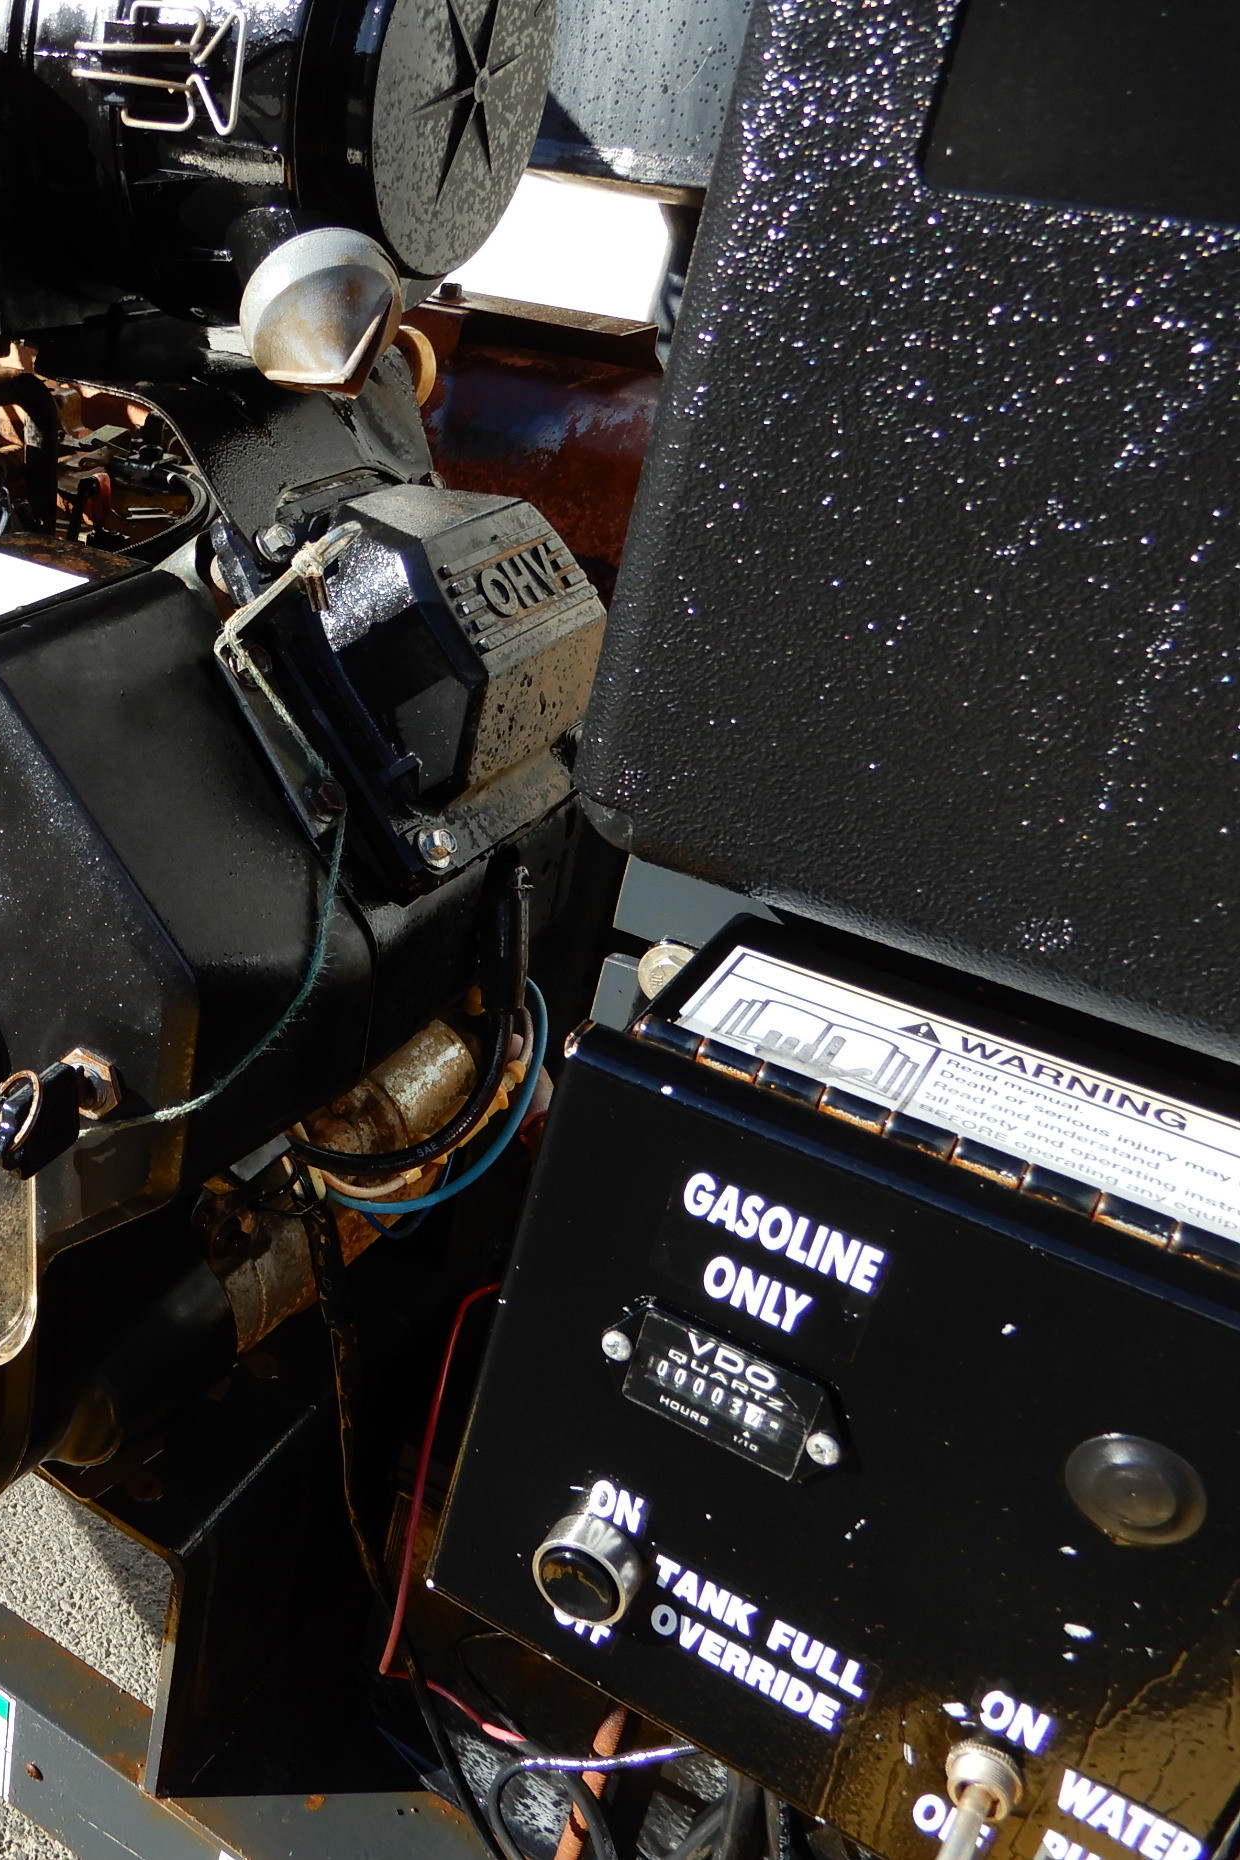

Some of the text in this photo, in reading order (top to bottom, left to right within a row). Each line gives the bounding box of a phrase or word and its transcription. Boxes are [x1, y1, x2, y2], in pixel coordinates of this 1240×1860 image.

[480, 544, 565, 617] OHV
[933, 1080, 1160, 1170] Read and understand
[939, 1069, 1232, 1182] Death or serious injury may
[946, 1058, 1083, 1113] Read manual.
[961, 1036, 1188, 1132] WARNING
[416, 1141, 439, 1157] SAE
[918, 1103, 1240, 1230] BEFORE operating any equip
[924, 1091, 950, 1106] all
[954, 1103, 1018, 1131] safety
[1024, 1130, 1064, 1149] and
[1071, 1146, 1177, 1192] operating
[683, 1172, 886, 1293] GASOLINE
[703, 1256, 813, 1332] ONLY
[668, 1348, 786, 1412] QUARTZ
[687, 1331, 778, 1391] VDO
[659, 1394, 759, 1452] HOURS 1/10
[588, 1479, 645, 1534] ON
[650, 1604, 841, 1731] OVERRIDE
[655, 1554, 863, 1698] TANK FULL
[979, 1689, 1051, 1752] ON
[1057, 1768, 1202, 1860] WATER
